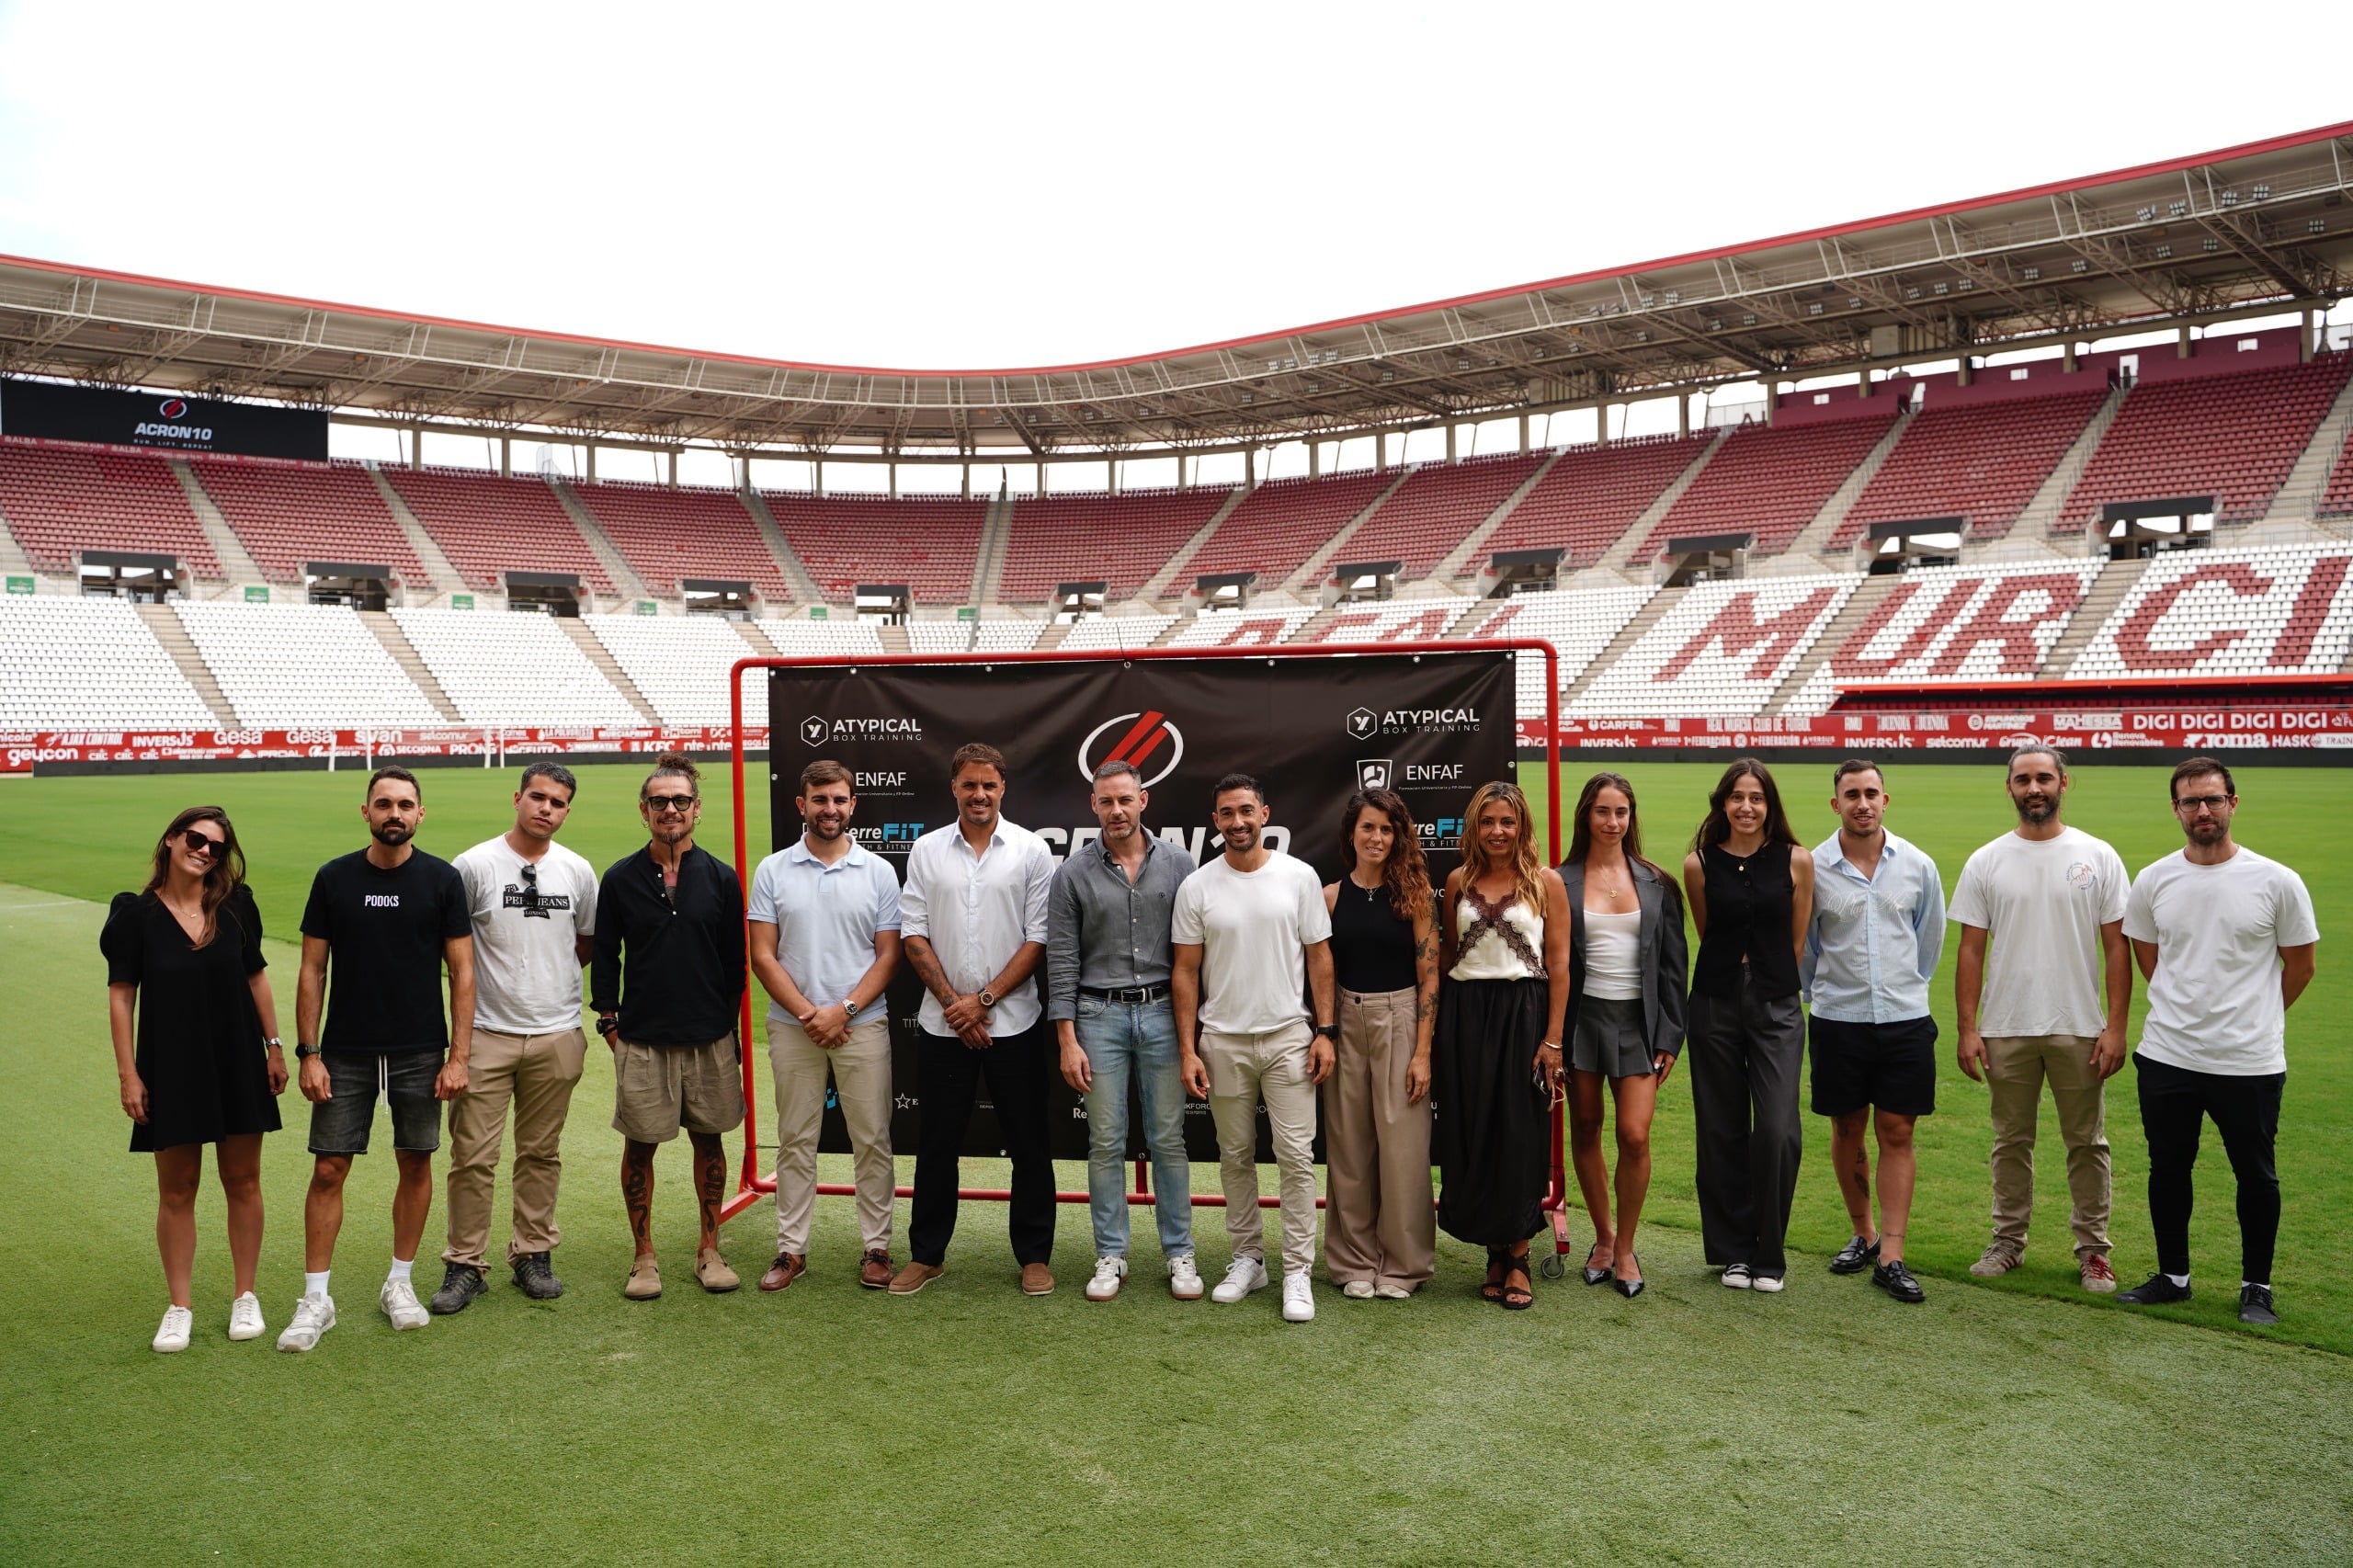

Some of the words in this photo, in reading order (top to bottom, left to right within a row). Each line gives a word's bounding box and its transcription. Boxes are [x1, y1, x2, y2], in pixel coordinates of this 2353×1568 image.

[135, 423, 213, 440] ACRON10
[1382, 708, 1481, 725] ATYPICAL
[2133, 714, 2175, 730] DIGI
[2181, 714, 2223, 730] DIGI
[2230, 713, 2276, 730] DIGI
[2281, 712, 2328, 729] DIGI
[833, 719, 922, 733] ATYPICAL
[1416, 724, 1481, 733] TRAINING
[1599, 720, 1643, 731] CARFER
[61, 733, 85, 745] AJAX
[85, 733, 123, 745] CONTROL
[213, 731, 263, 745] Gesa
[286, 731, 332, 744] Gesa
[864, 733, 923, 742] TRAINING
[1926, 735, 1989, 748] setcomur
[644, 740, 676, 752] KFC
[7, 748, 79, 767] geycon
[1406, 764, 1463, 780] ENFAF
[855, 772, 907, 787] ENFAF
[537, 897, 569, 907] JEANS
